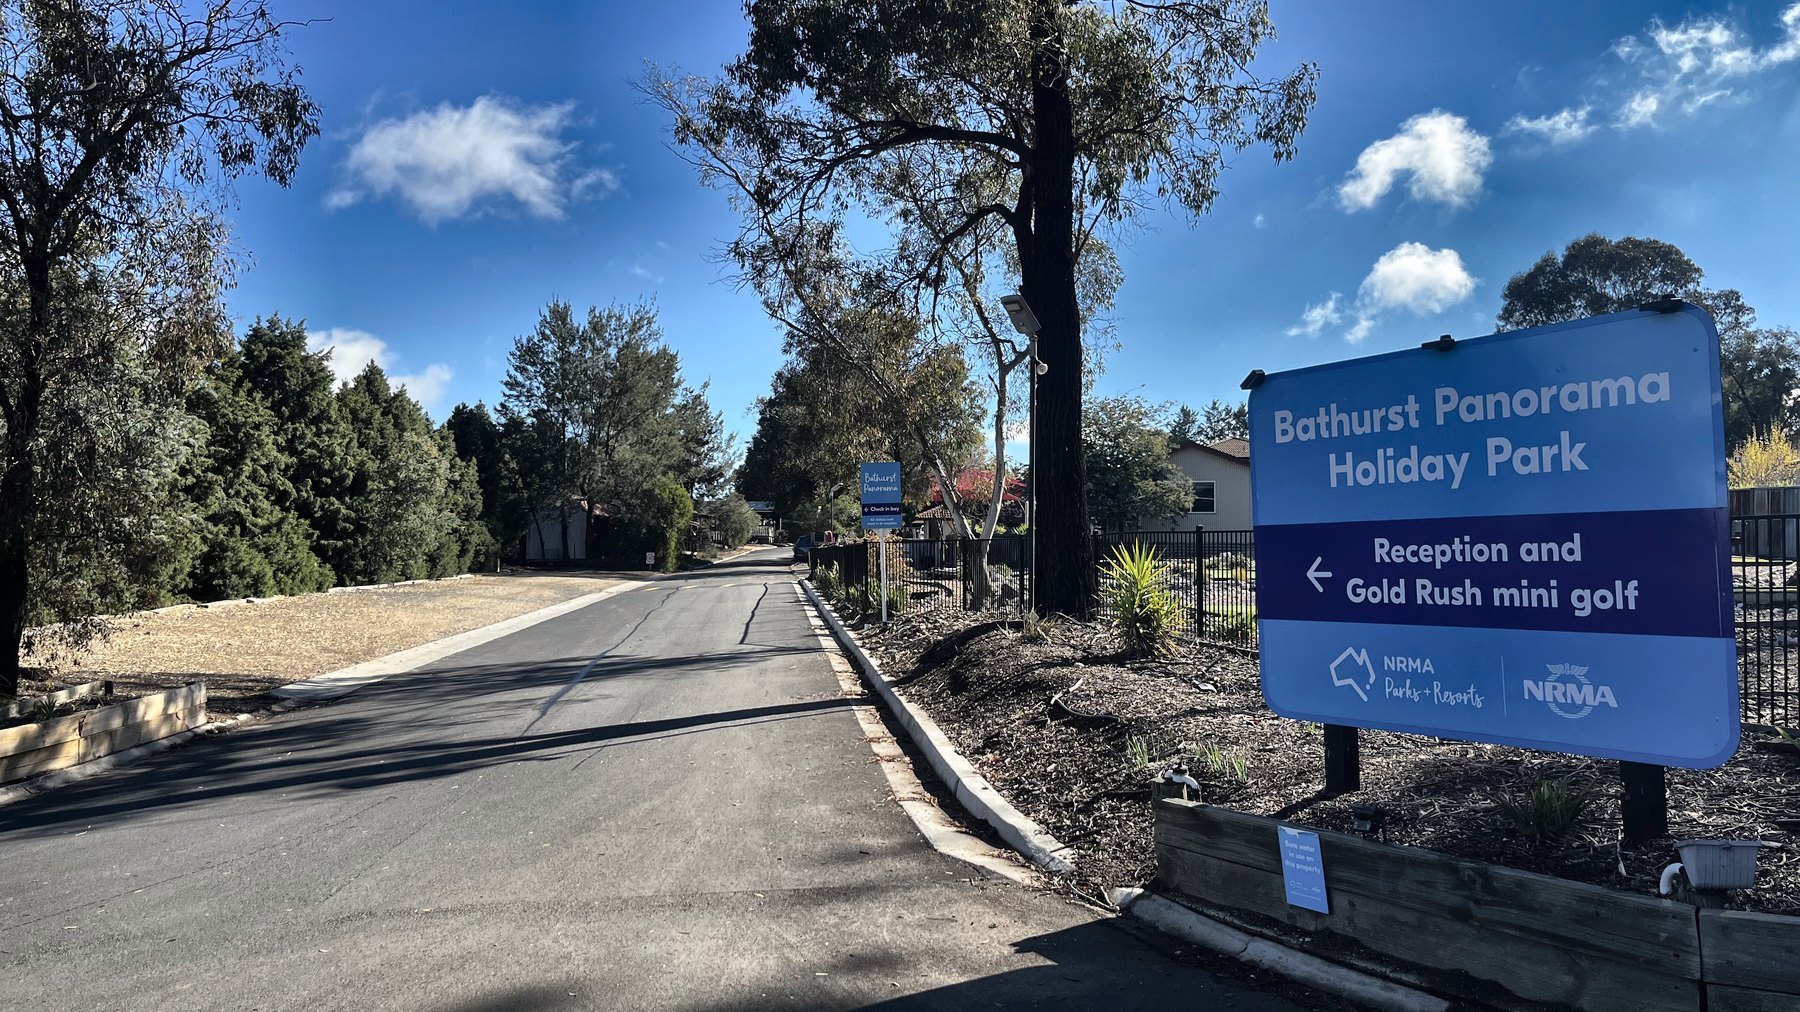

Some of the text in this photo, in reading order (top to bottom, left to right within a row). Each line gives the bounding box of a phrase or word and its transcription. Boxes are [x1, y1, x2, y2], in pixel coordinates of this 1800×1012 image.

[1274, 371, 1670, 444] Bathurst Panorama
[1329, 430, 1589, 490] Holiday Park
[864, 473, 896, 483] Bathurst
[864, 484, 898, 494] Panorama
[1374, 533, 1582, 569] Reception and
[1346, 578, 1639, 617] Gold Rush mini golf
[1384, 656, 1434, 674] NRMA
[1385, 677, 1420, 702] Parks
[1434, 681, 1485, 709] Resorts
[1523, 680, 1618, 708] NRMA
[1285, 840, 1315, 852] Bore water
[1285, 860, 1320, 875] this property
